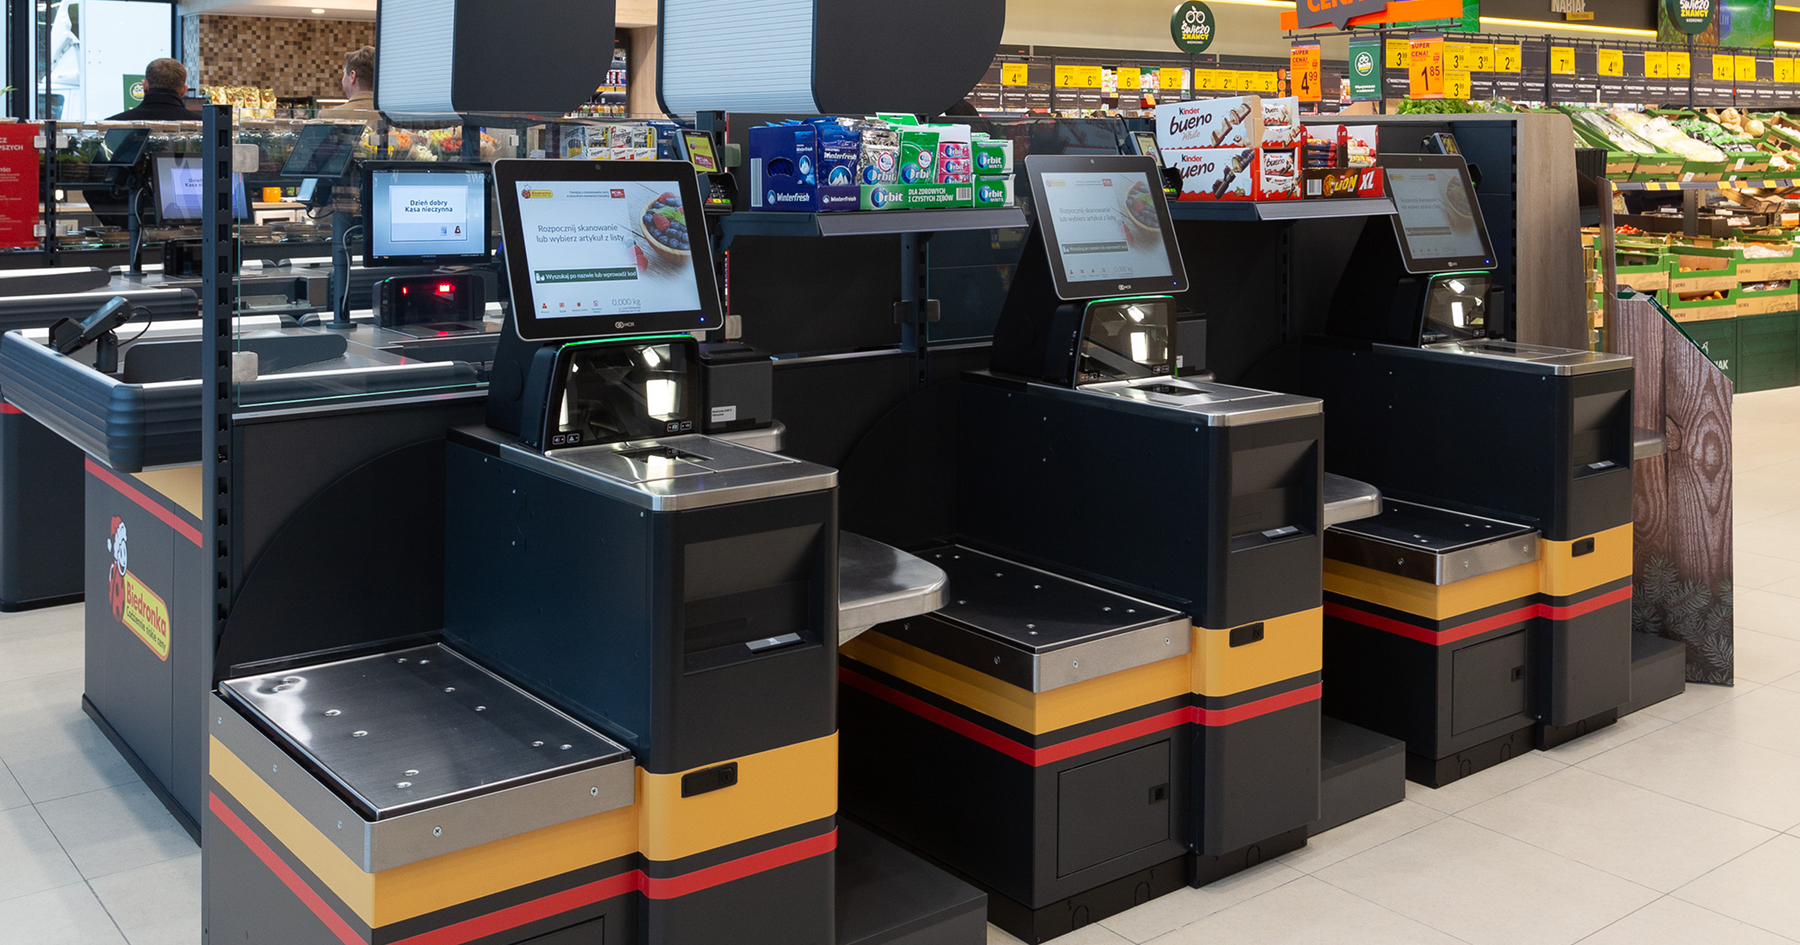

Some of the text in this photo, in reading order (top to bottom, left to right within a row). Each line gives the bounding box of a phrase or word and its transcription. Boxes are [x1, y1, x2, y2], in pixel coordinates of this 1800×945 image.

[1301, 71, 1318, 94] 4 99
[1421, 66, 1429, 91] 1
[1429, 66, 1440, 76] 85
[1170, 113, 1212, 135] bueno
[824, 151, 857, 160] Winterfresh
[945, 145, 963, 158] Orbit
[945, 160, 964, 173] Orbit
[976, 152, 1002, 169] Orbit
[1266, 158, 1285, 166] bueno
[1174, 162, 1215, 180] ueno
[1359, 171, 1375, 190] XL
[777, 192, 810, 202] Winterfresh
[871, 187, 903, 208] Orbit
[936, 194, 954, 202] ZĘBÓW
[978, 185, 1003, 202] Orbit
[429, 199, 448, 207] dobry
[538, 223, 618, 233] Rozpocznij skanowanie
[549, 235, 577, 243] wybierz
[579, 234, 604, 243] artykuł
[610, 233, 625, 242] listy
[603, 271, 627, 279] wprowadź
[612, 298, 642, 307] 0,000 kg
[127, 581, 166, 637] Biedronka
